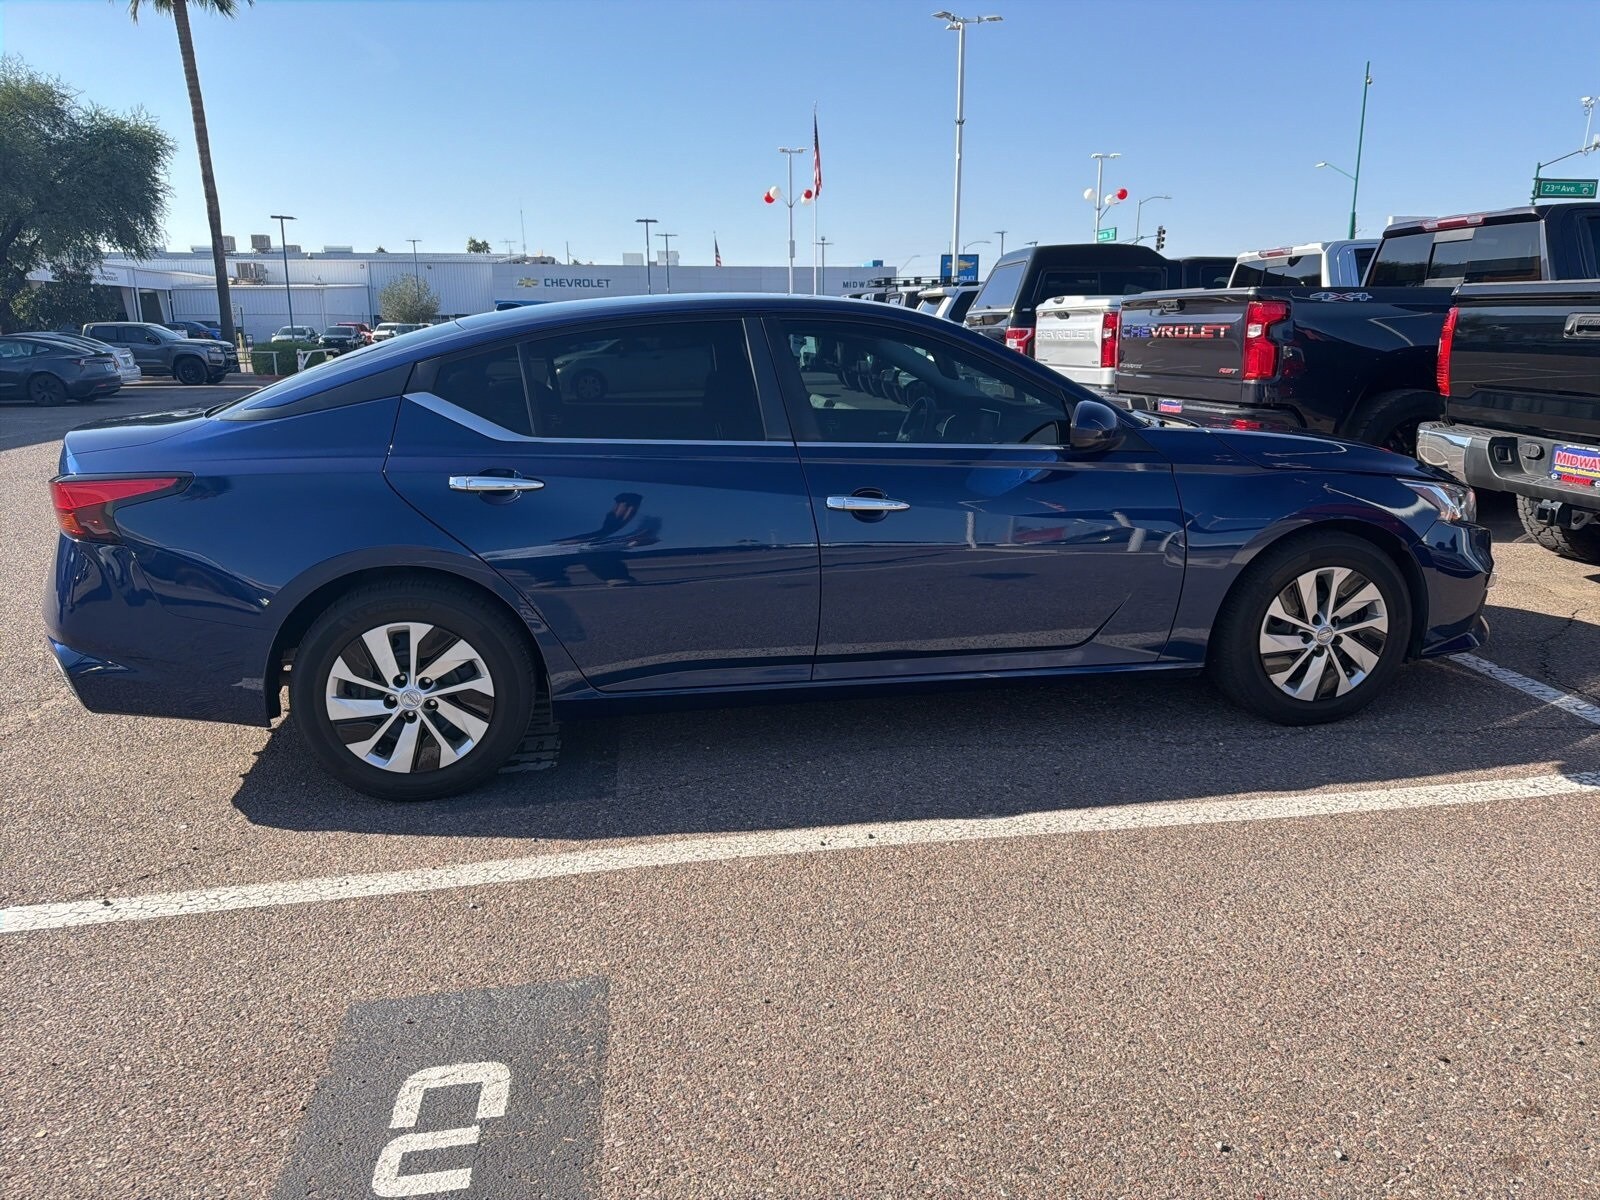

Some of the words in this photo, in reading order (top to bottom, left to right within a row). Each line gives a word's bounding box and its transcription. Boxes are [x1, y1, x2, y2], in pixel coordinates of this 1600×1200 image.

[544, 278, 611, 288] CHEVROLET
[1122, 324, 1231, 338] CHEVROLET
[1554, 451, 1600, 471] MIDWA
